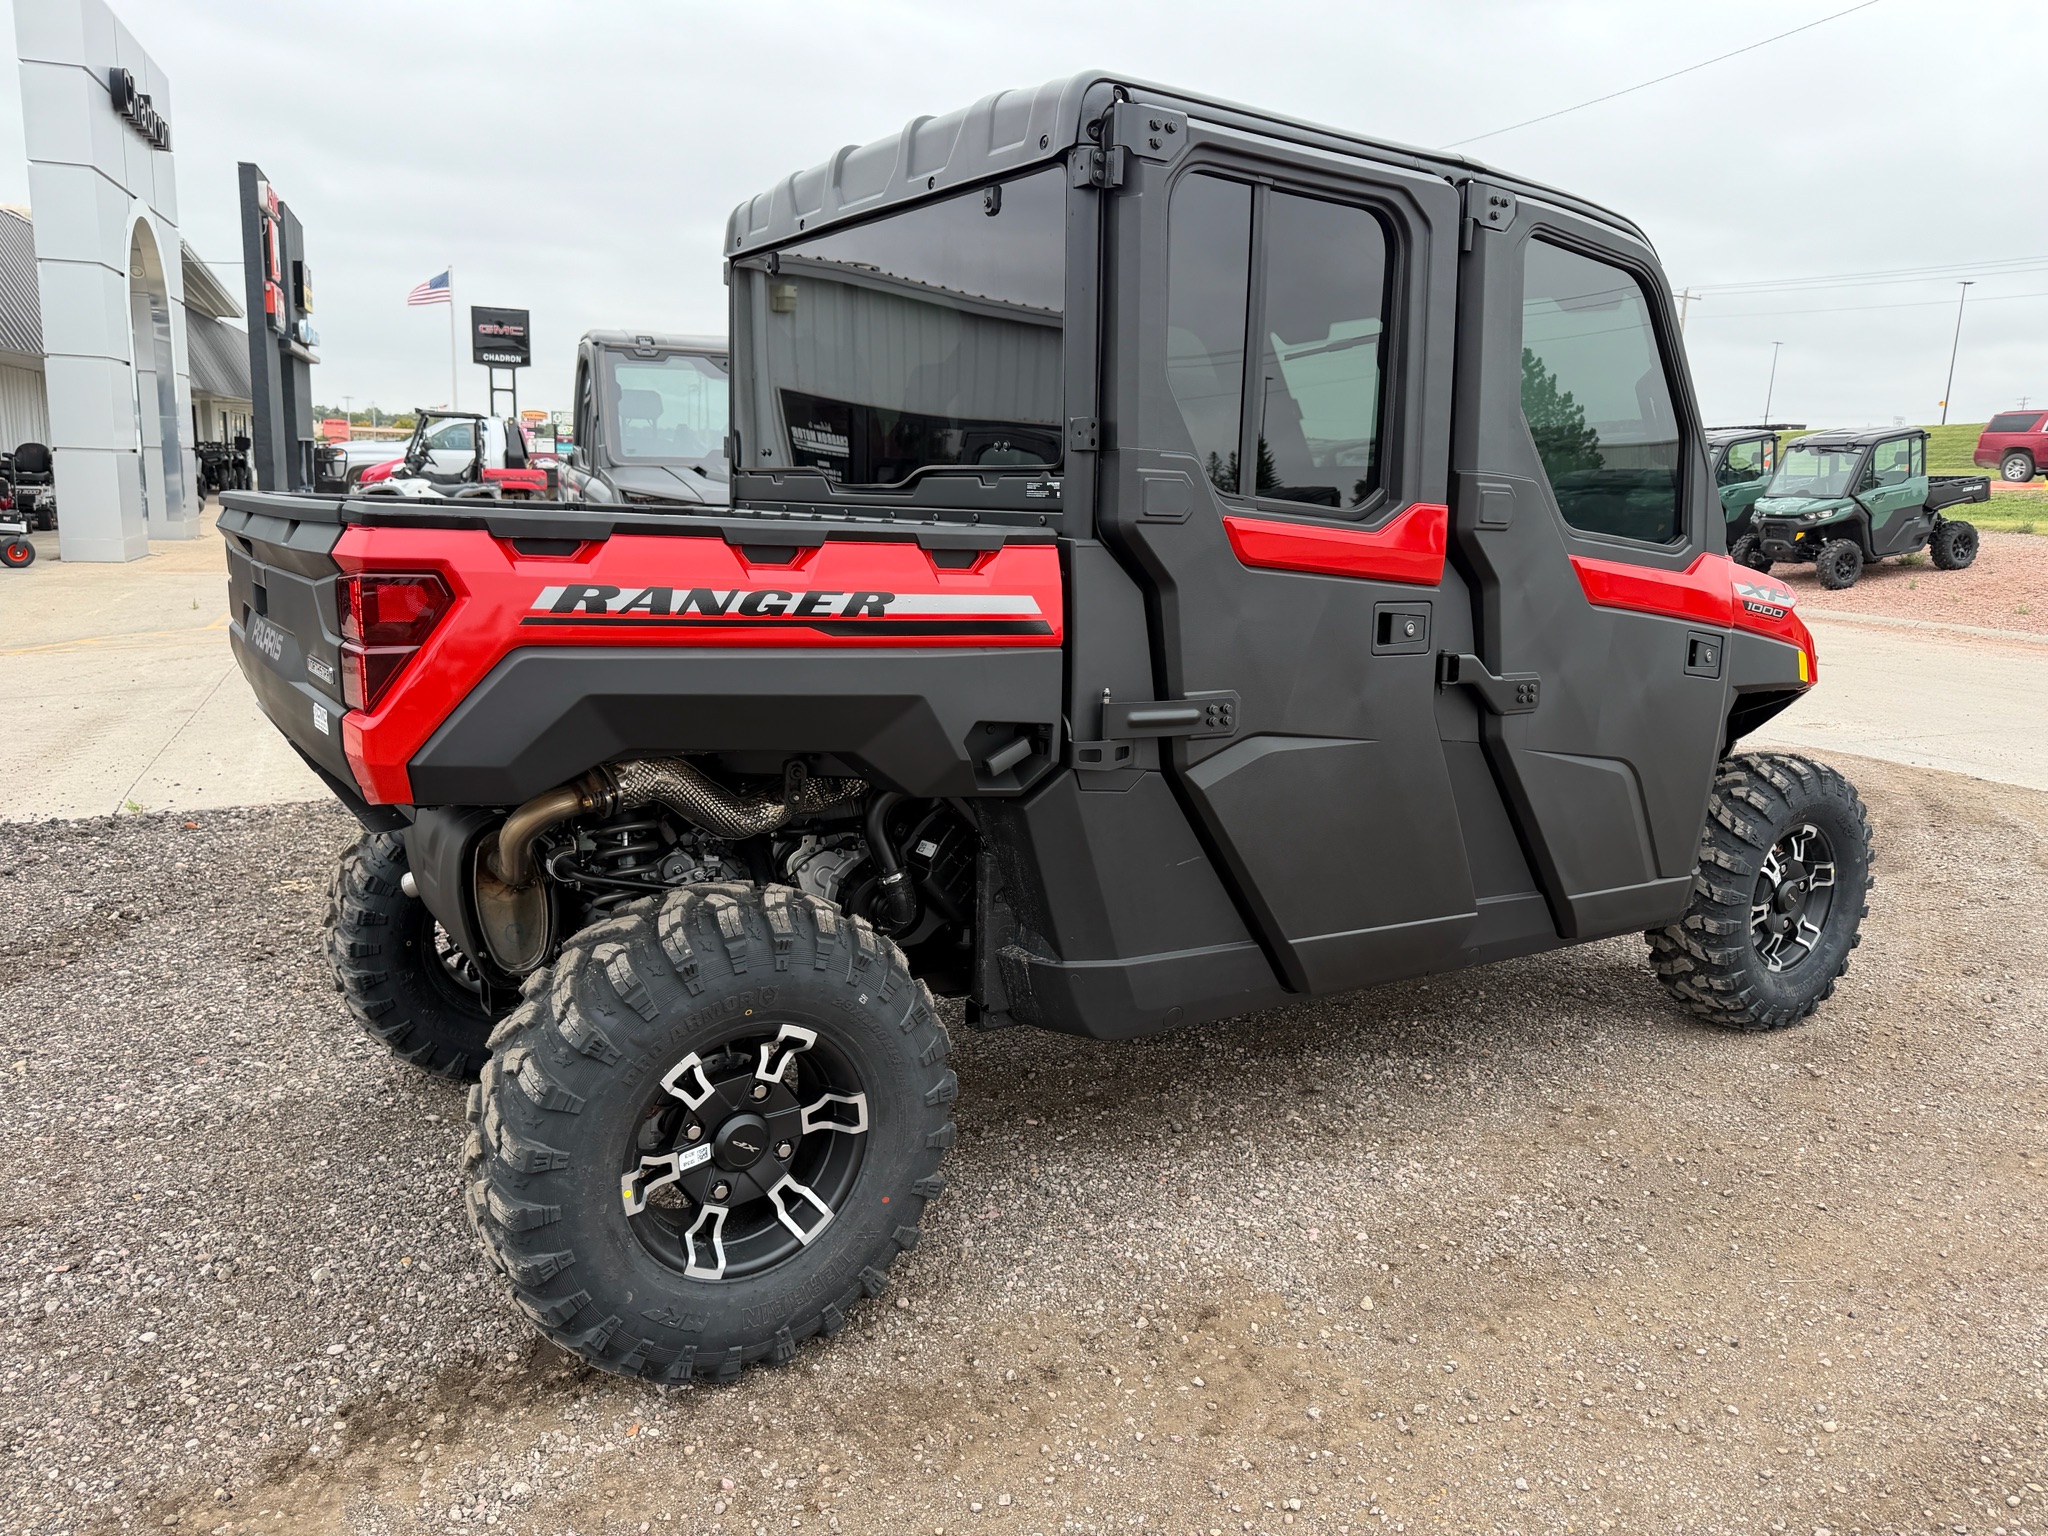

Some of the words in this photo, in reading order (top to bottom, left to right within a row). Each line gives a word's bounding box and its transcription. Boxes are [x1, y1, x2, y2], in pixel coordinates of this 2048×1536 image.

[121, 67, 172, 152] Chadron
[478, 324, 524, 337] GMC
[482, 352, 522, 363] CHADRON
[549, 583, 897, 618] RANGER
[1740, 581, 1791, 602] XP
[1747, 602, 1784, 618] 1000
[251, 617, 284, 661] POLARIS
[669, 991, 755, 1045] ARMOR
